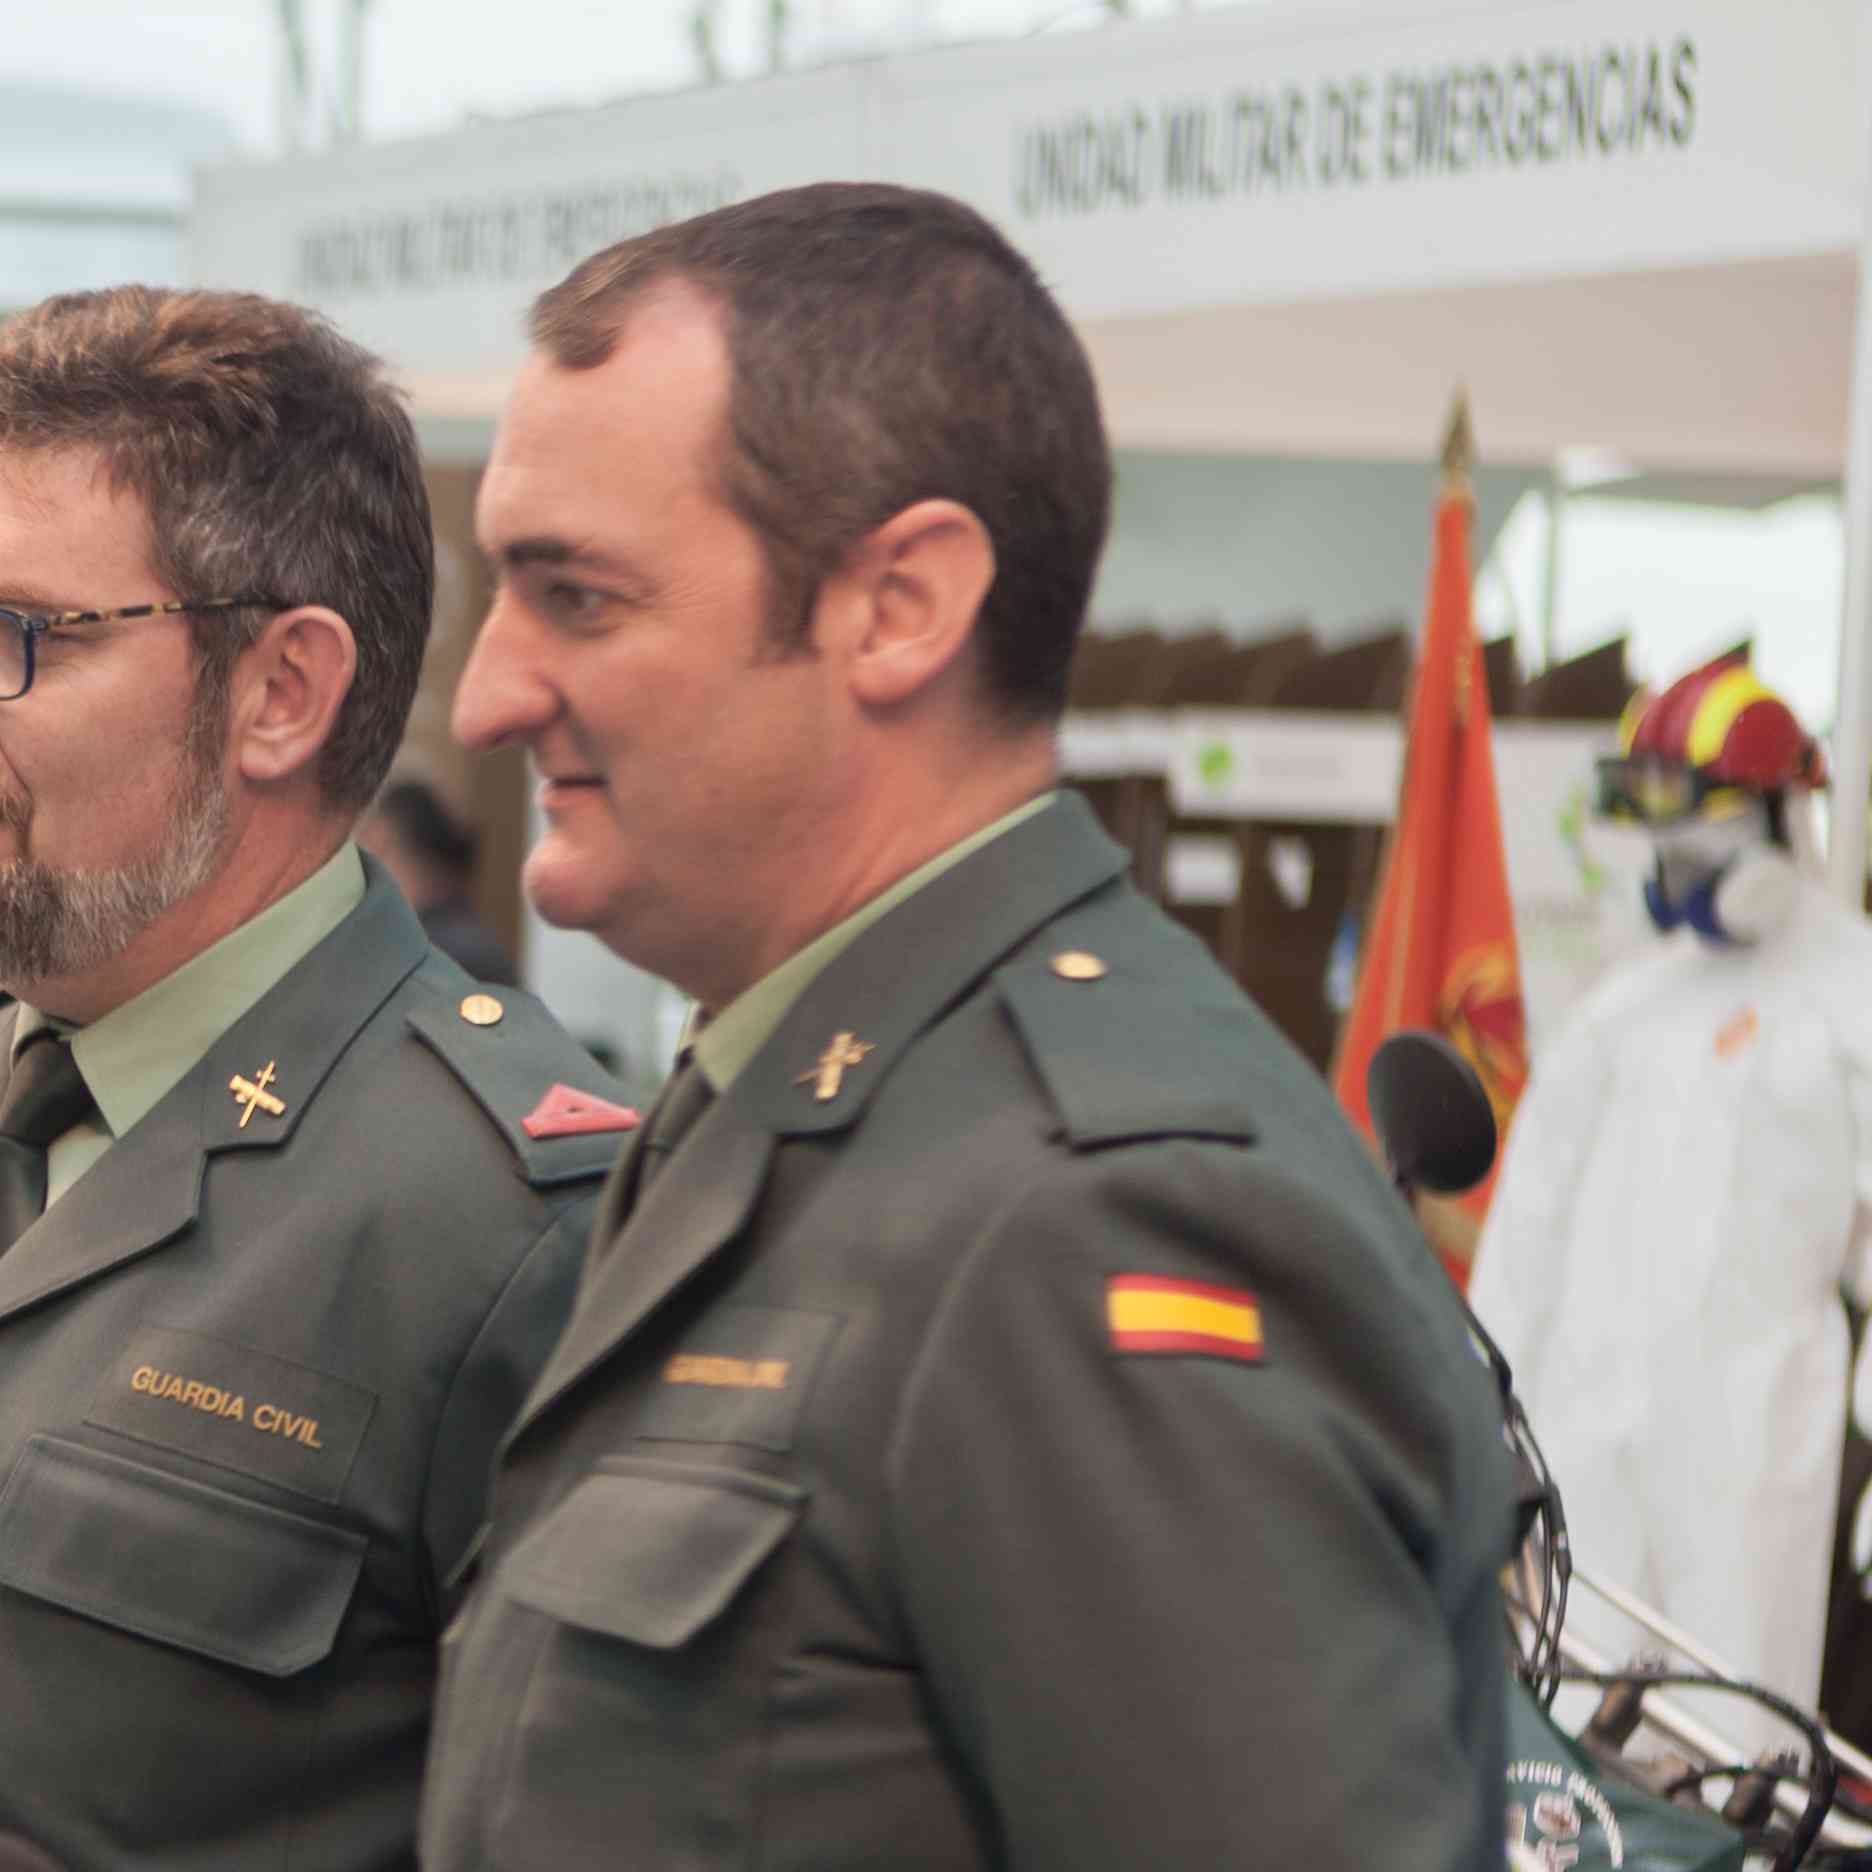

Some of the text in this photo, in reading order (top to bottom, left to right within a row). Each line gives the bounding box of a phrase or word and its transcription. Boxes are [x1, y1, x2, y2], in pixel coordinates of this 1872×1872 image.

[1162, 88, 1310, 204] MILITAR
[1314, 78, 1372, 184] DE
[1384, 36, 1698, 178] EMERGENCIAS
[132, 1365, 323, 1448] GUARDIA CIVIL
